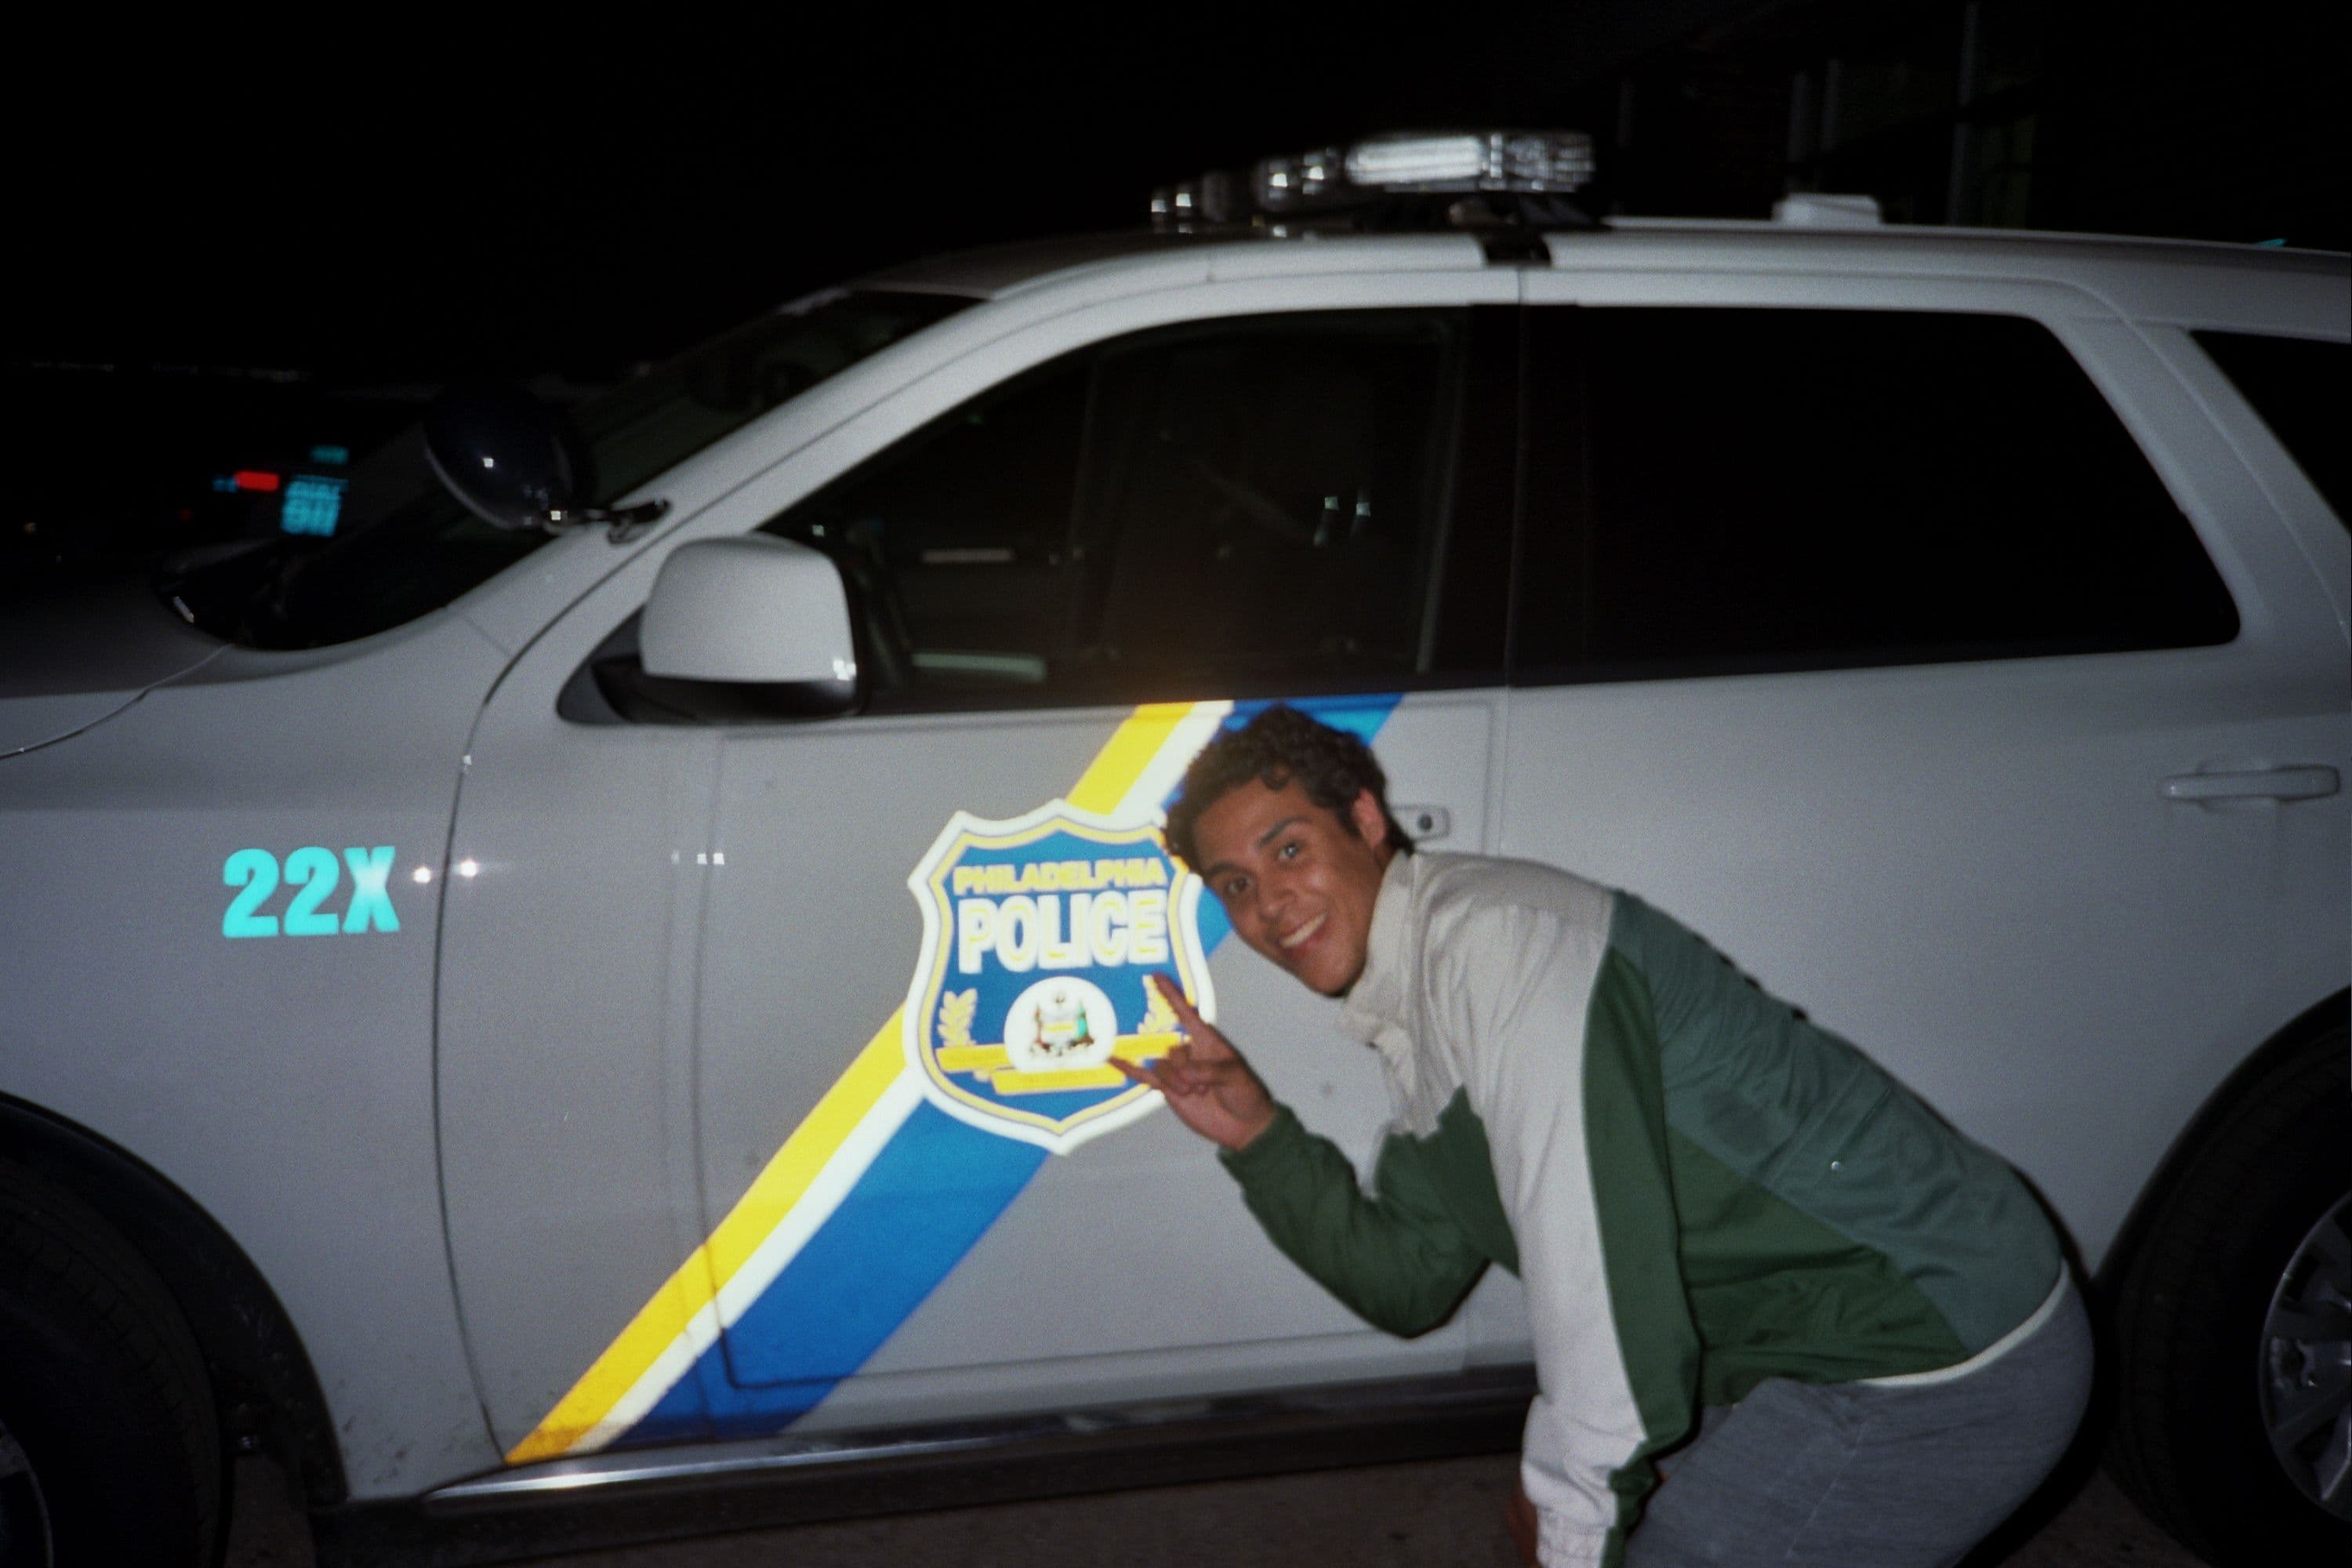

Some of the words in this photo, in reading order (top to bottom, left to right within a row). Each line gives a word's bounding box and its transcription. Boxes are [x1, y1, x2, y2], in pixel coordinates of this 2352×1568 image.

[223, 846, 400, 938] 22X
[953, 858, 1167, 894] PHILADELPHIA
[958, 890, 1169, 974] POLICE
